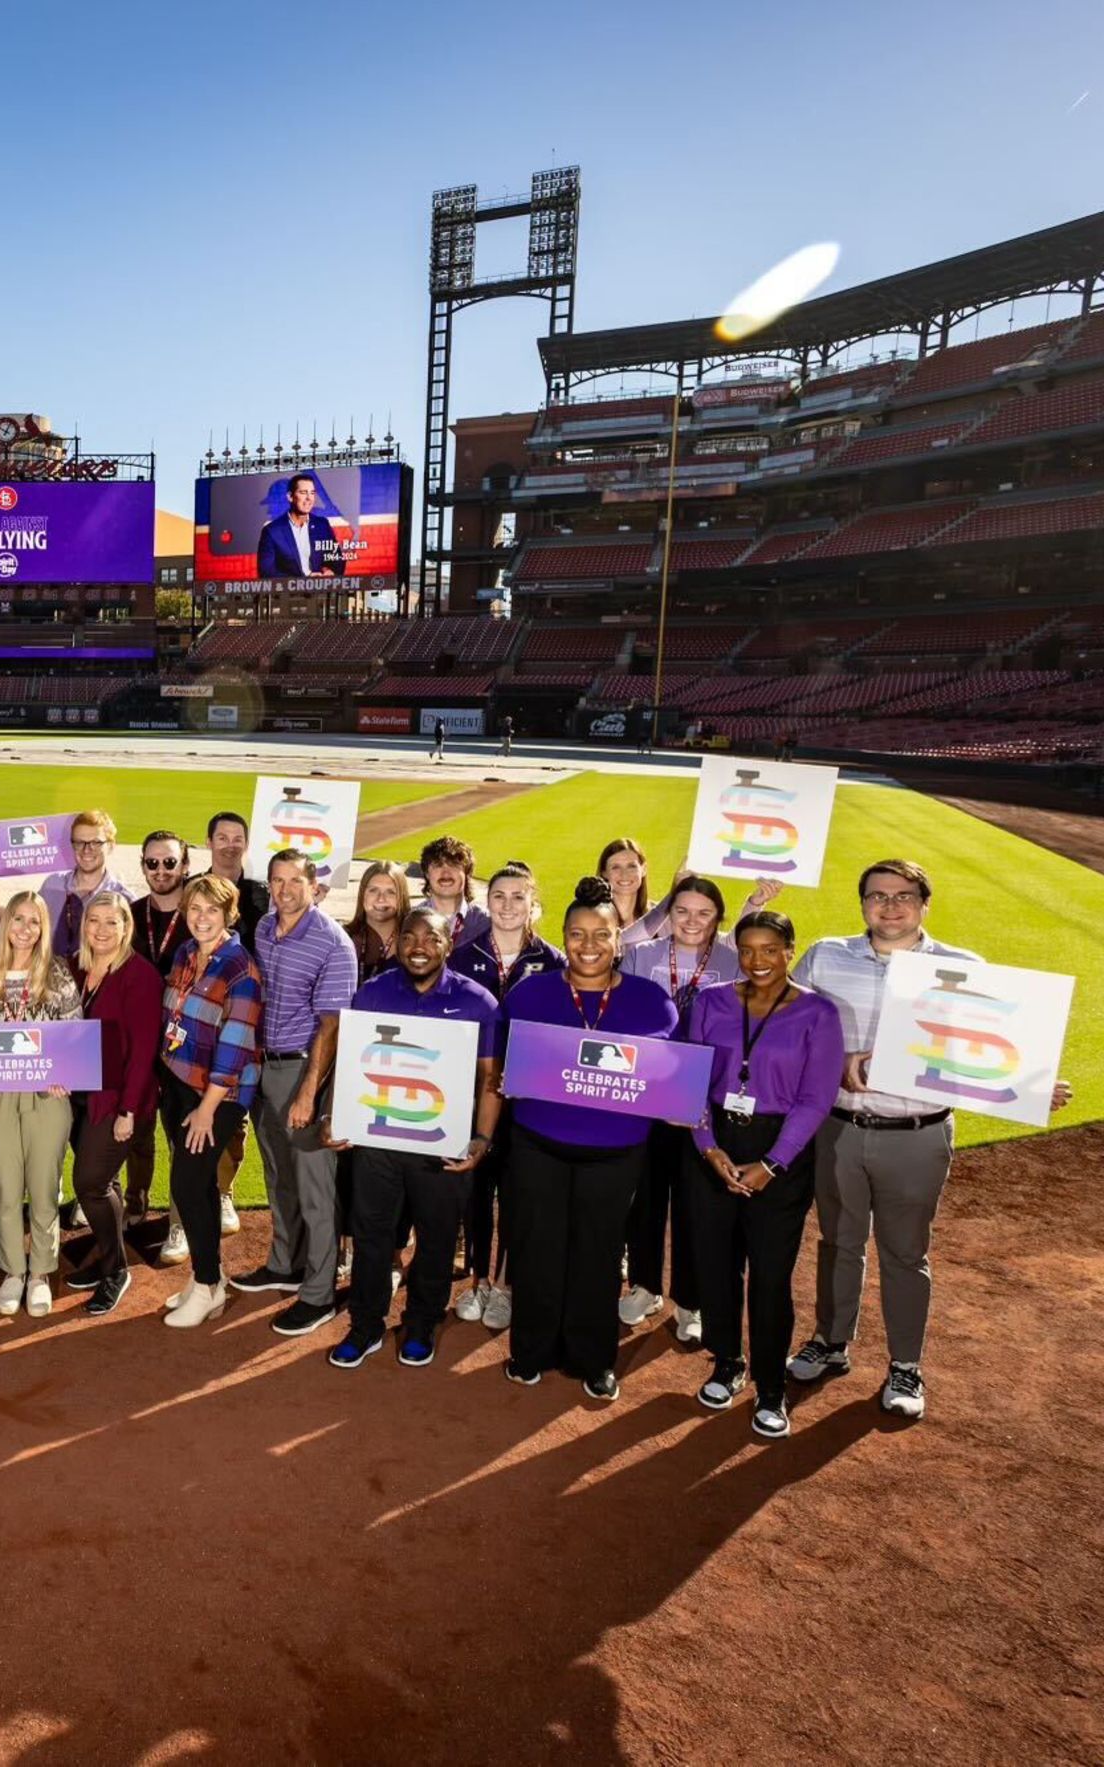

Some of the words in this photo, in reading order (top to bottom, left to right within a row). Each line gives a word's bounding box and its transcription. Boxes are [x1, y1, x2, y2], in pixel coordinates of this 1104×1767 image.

[724, 361, 779, 372] BUDWEISER
[730, 386, 784, 397] BUDWEISER
[218, 457, 273, 472] WORLD
[280, 450, 381, 467] CHAMPIONS
[314, 540, 340, 553] Billy
[343, 539, 368, 550] Bean
[1, 565, 17, 576] Day
[225, 581, 272, 594] BROWN
[275, 583, 284, 592] &
[287, 578, 361, 592] CROUPPEN
[1, 846, 58, 859] CELEBRATES
[6, 858, 35, 868] SPIRIT
[36, 855, 55, 865] DAY
[26, 1070, 48, 1080] DAY
[561, 1069, 646, 1091] CELEBRATES
[565, 1082, 607, 1099] SPIRIT
[611, 1089, 640, 1103] DAY
